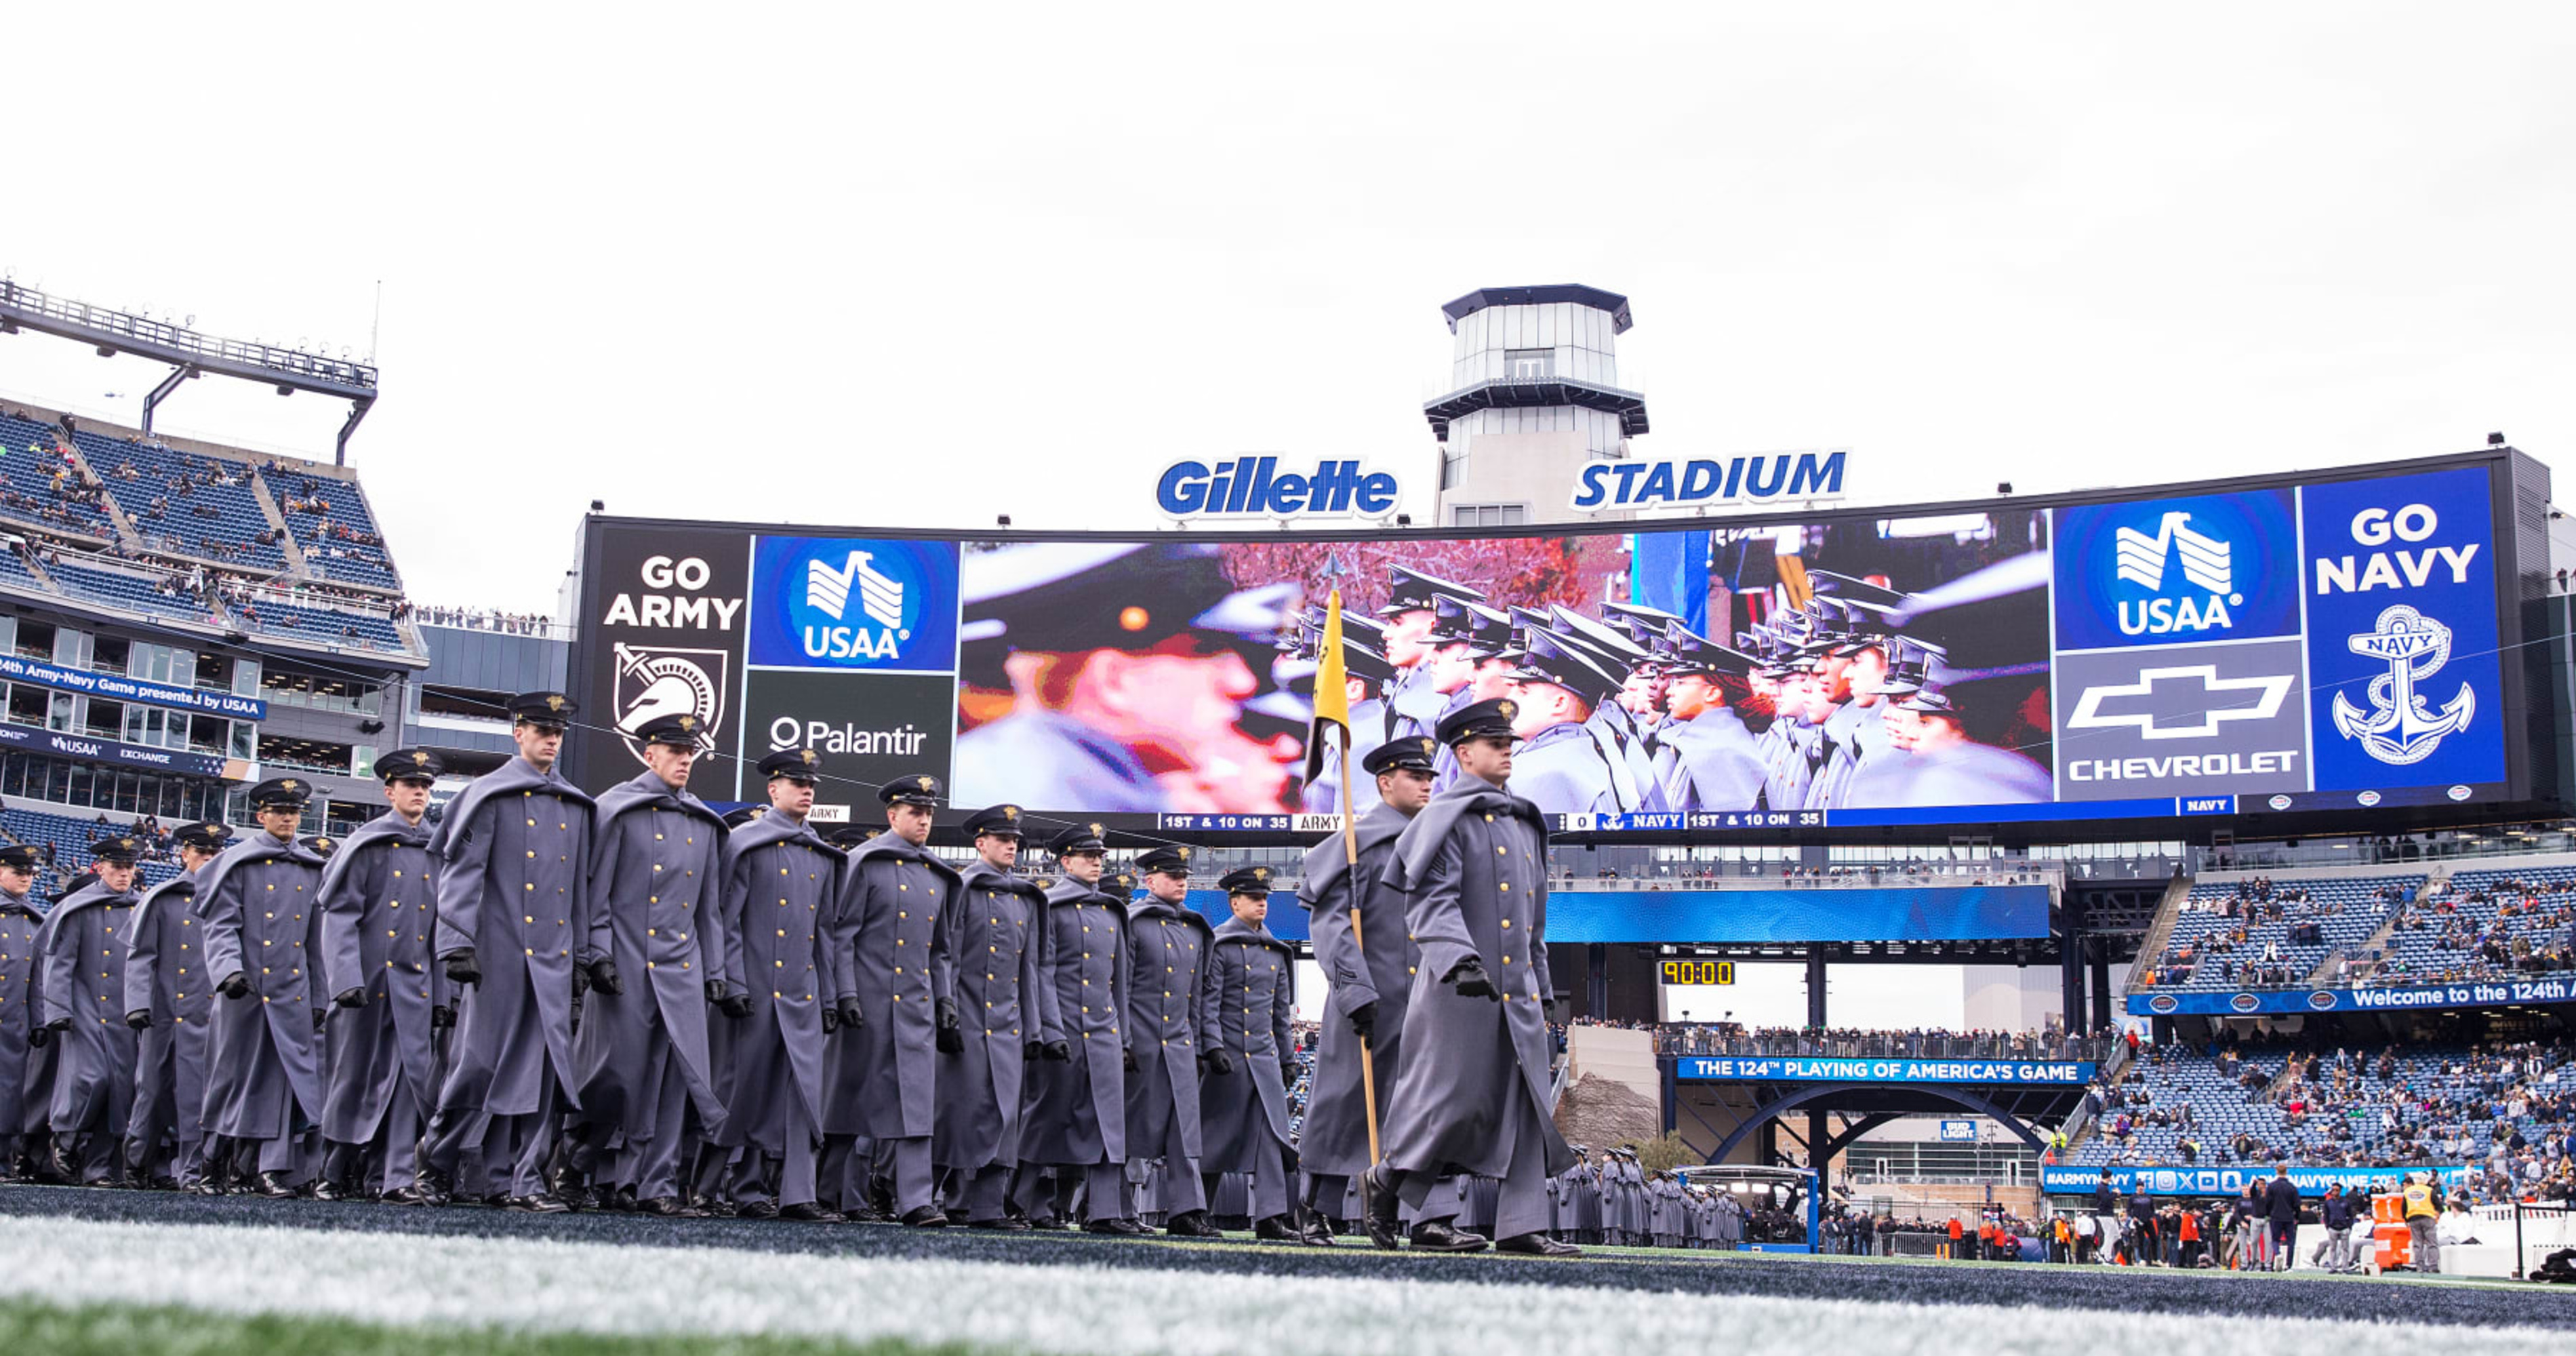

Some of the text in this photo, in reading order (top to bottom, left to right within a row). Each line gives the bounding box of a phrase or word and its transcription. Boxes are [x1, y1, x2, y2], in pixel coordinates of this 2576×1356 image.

[1156, 456, 1398, 515] Gillette
[1574, 452, 1847, 506] STADIUM
[2350, 503, 2438, 546] GO
[641, 555, 710, 591] GO
[2316, 543, 2481, 595] NAVY
[603, 593, 744, 631] ARMY
[2367, 635, 2433, 656] NAVY
[25, 664, 96, 689] Army-Navy
[98, 679, 136, 695] Game
[138, 686, 203, 705] presented
[204, 696, 220, 710] by
[222, 698, 259, 715] USAA
[806, 720, 927, 755] Palantir
[67, 740, 99, 757] USAA
[119, 749, 172, 765] EXCHANGE
[2068, 749, 2299, 782] CHEVROLET
[810, 807, 839, 819] ARMY
[2187, 799, 2226, 812] NAVY
[1165, 816, 1288, 829] 1ST & 10 ON 35
[1300, 815, 1341, 830] ARMY
[1633, 814, 1681, 828] NAVY
[1689, 813, 1819, 827] 1ST & 10 ON 35
[1664, 961, 1732, 984] 90:00
[2353, 989, 2444, 1007] Welcome
[2448, 987, 2470, 1003] to
[2473, 984, 2507, 1001] the
[2511, 980, 2566, 1001] 124th
[1695, 1060, 1733, 1076] THE
[1784, 1062, 1868, 1077] PLAYING
[1873, 1062, 1901, 1078] OF
[1906, 1063, 2013, 1080] AMERICA'S
[2018, 1064, 2078, 1081] GAME
[1942, 1130, 1974, 1138] LIGHT
[1946, 1122, 1970, 1130] BUD
[2047, 1172, 2131, 1186] #ARMYNVY
